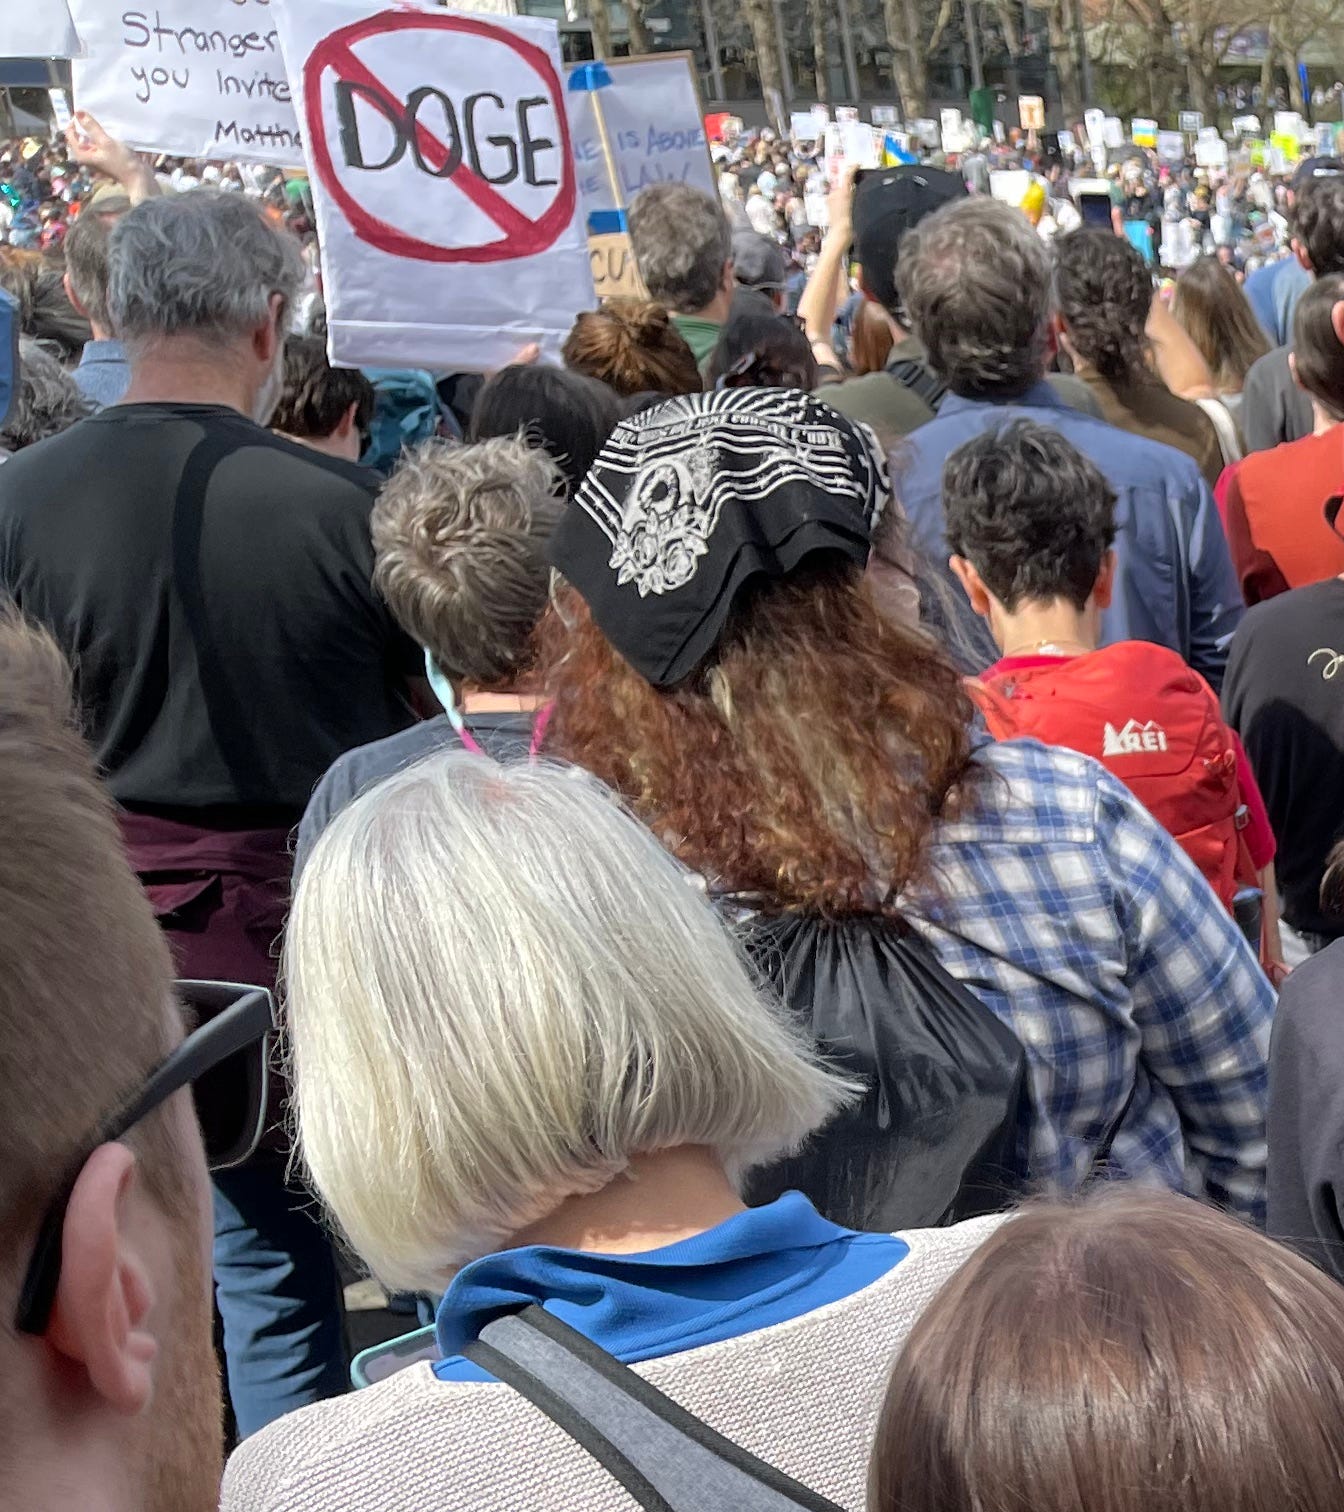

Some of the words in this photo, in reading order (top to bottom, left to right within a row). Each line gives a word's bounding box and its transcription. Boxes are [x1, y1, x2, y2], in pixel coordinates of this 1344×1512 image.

[122, 11, 279, 57] Stranger
[131, 66, 189, 103] you
[216, 69, 293, 102] Invite
[334, 80, 559, 187] DOGE
